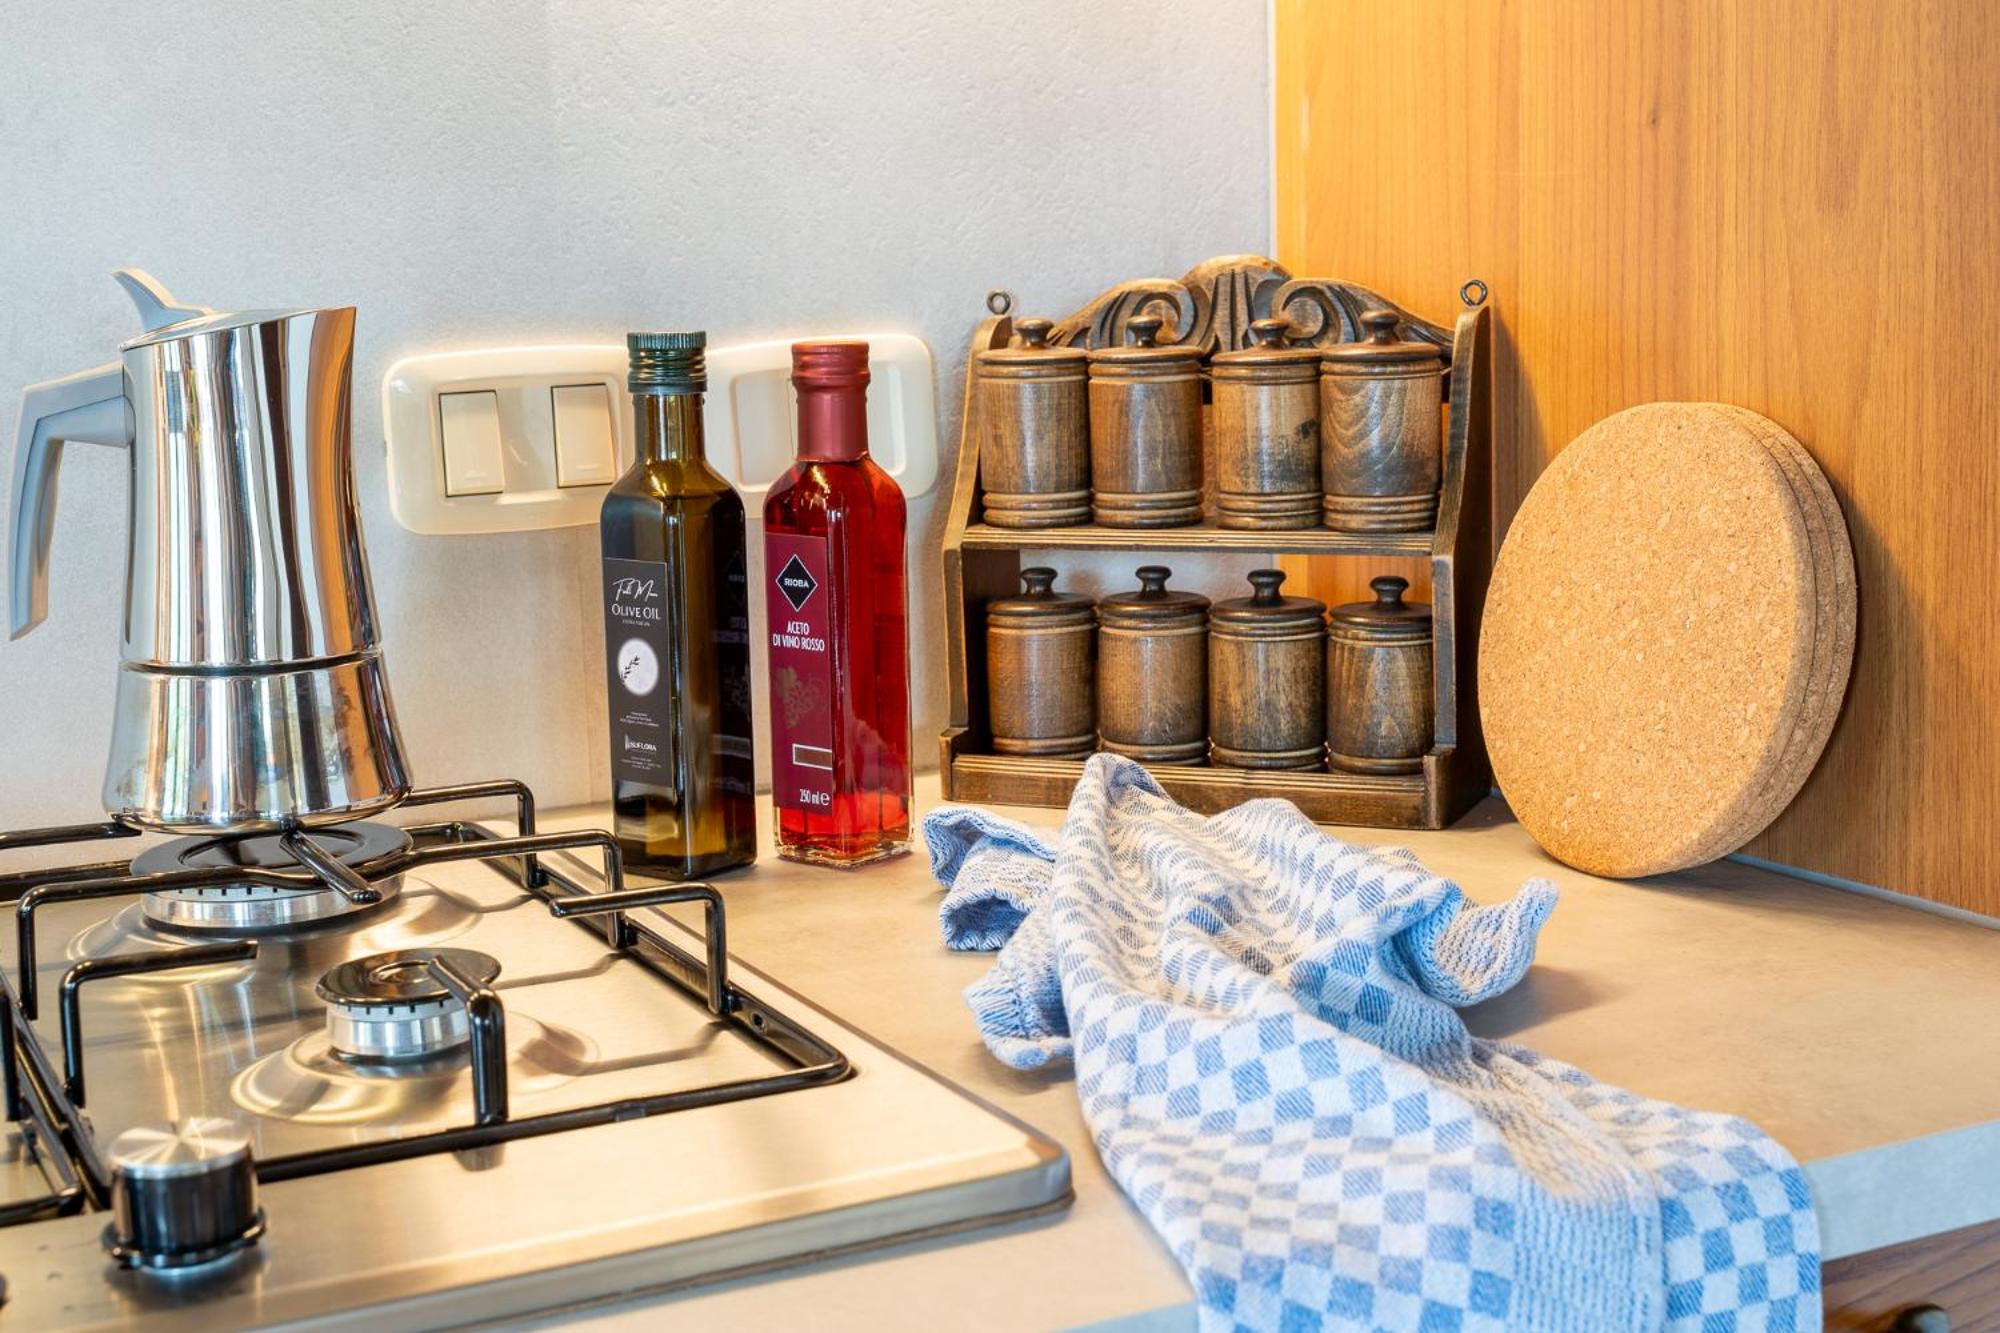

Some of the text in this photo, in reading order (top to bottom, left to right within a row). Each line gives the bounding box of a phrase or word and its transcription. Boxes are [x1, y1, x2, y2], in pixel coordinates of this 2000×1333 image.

[784, 578, 809, 588] RIOBA
[611, 603, 661, 620] OLIVE OIL
[787, 621, 810, 635] ACETO
[772, 634, 824, 652] DI VINO ROSSO
